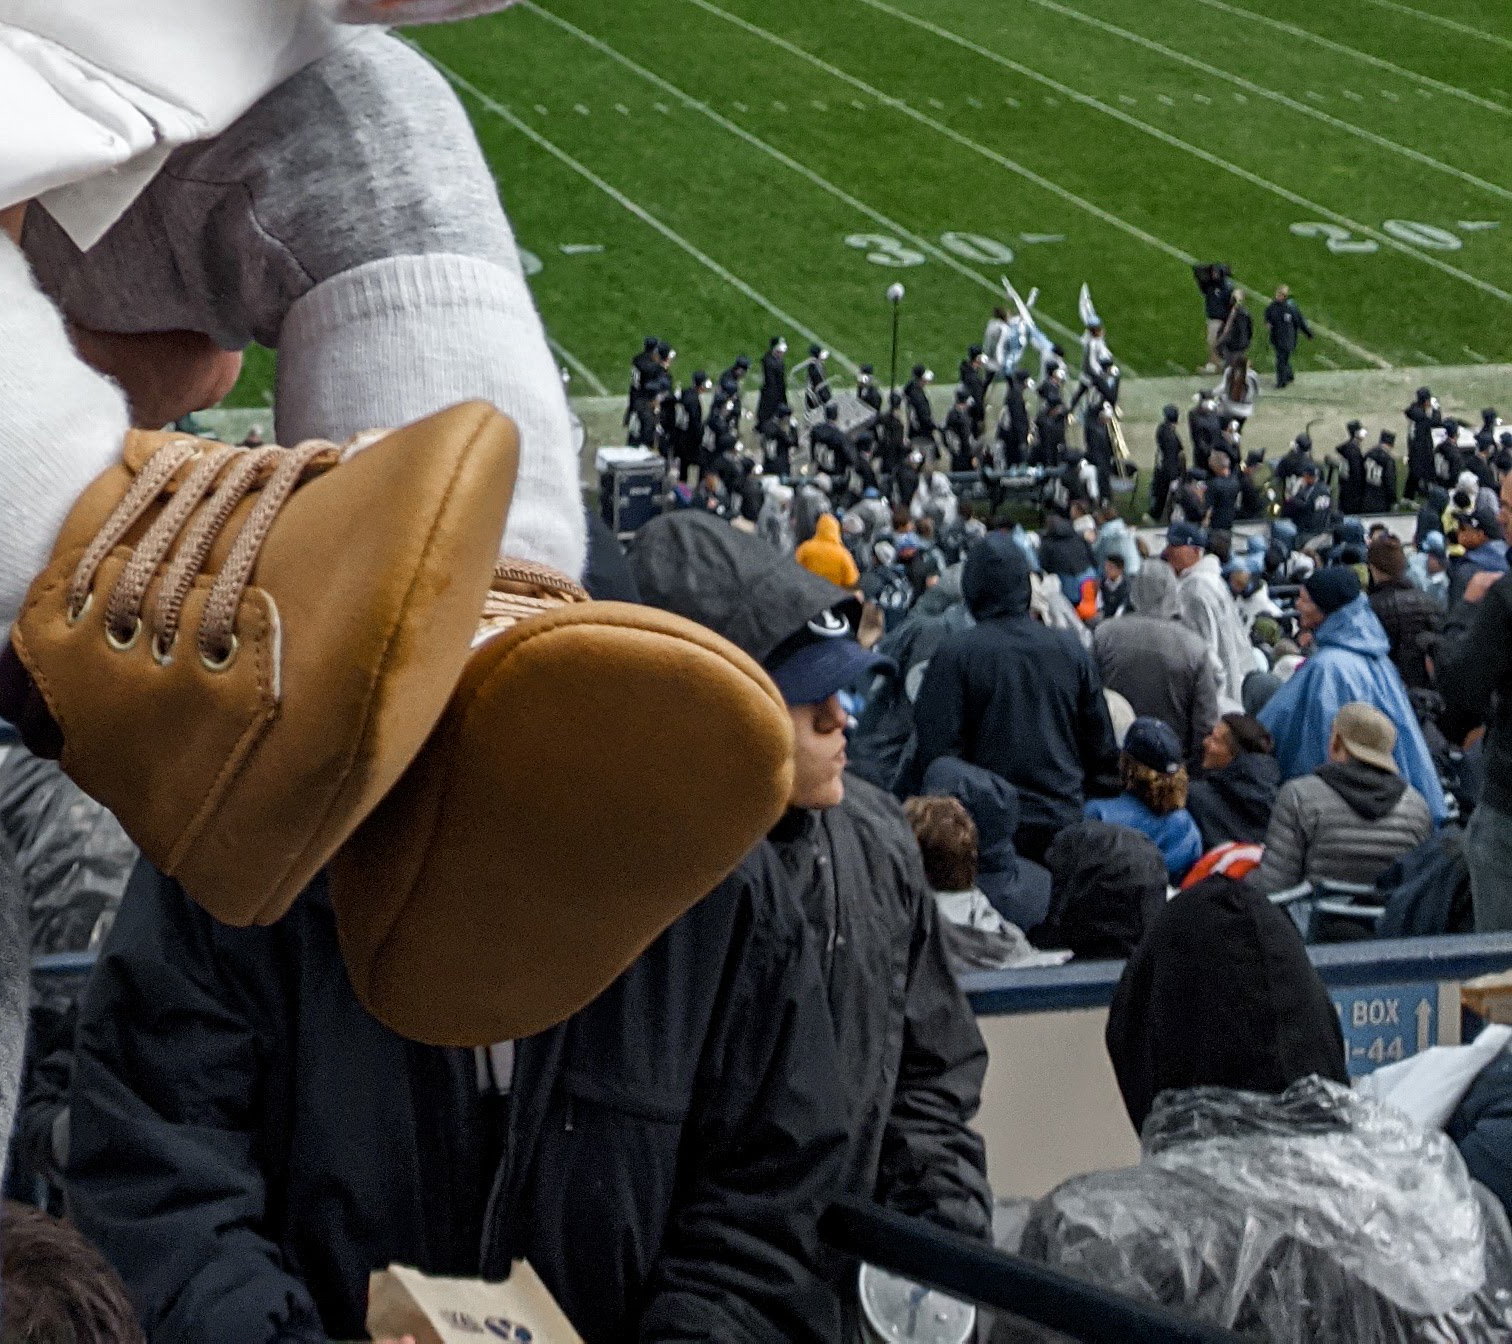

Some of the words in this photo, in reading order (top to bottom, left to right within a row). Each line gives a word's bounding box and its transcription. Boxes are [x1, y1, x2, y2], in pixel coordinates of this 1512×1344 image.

[844, 231, 1015, 268] 30
[1289, 219, 1464, 255] 20
[1352, 998, 1400, 1027] BOX
